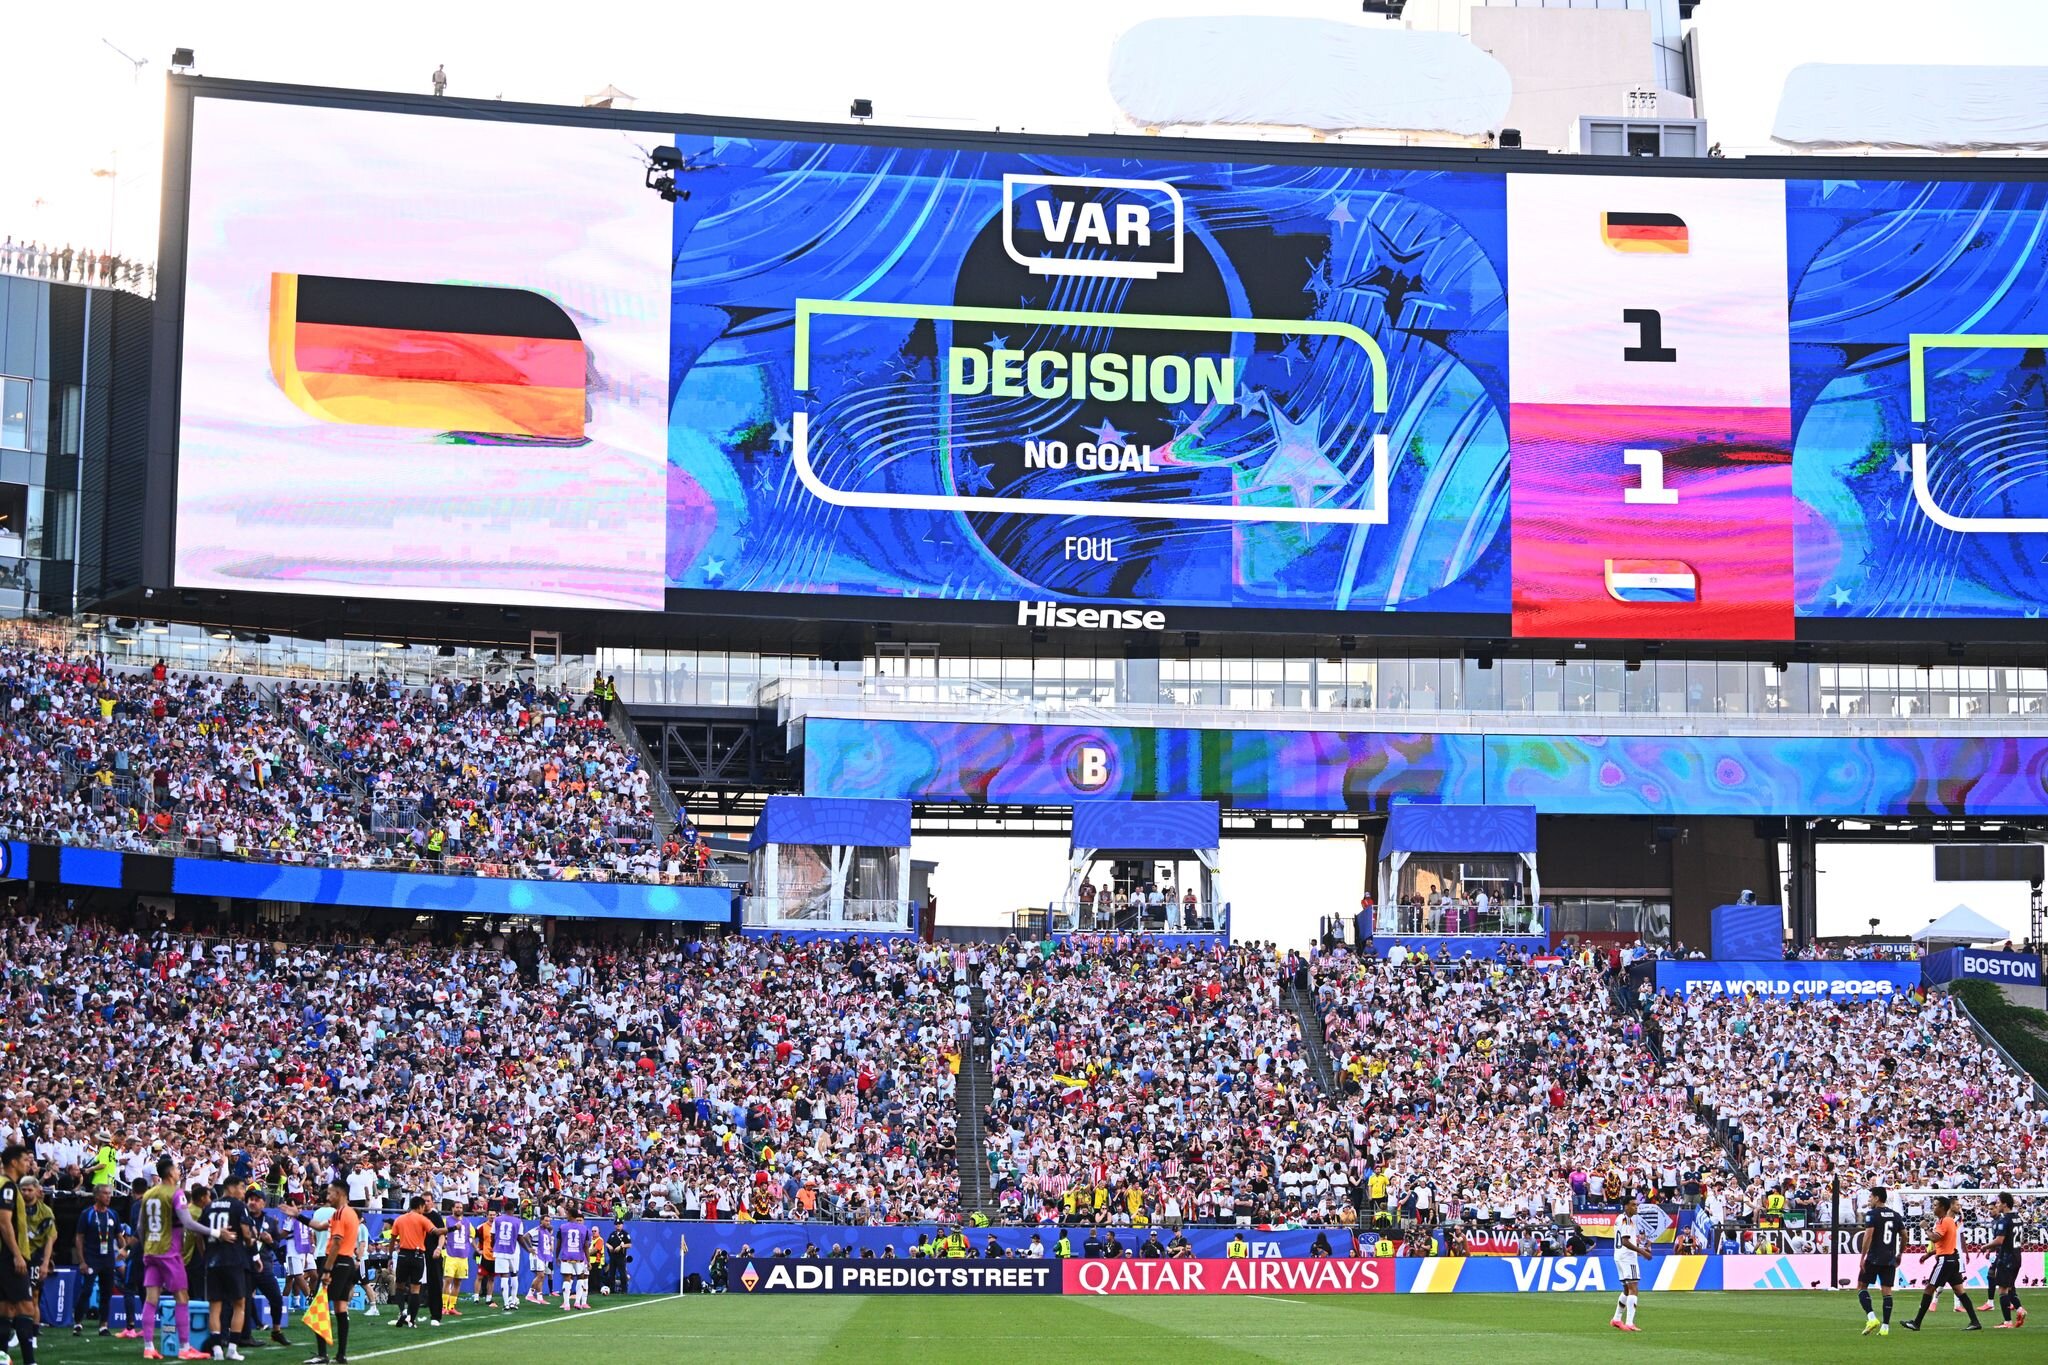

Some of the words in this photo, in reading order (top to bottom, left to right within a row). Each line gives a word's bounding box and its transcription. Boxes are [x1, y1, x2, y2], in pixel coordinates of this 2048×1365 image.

[1036, 200, 1151, 246] VAR
[1623, 308, 1677, 363] 1
[948, 346, 1235, 405] DECISION
[1024, 440, 1068, 469] NO
[1075, 442, 1160, 473] GOAL
[1623, 449, 1679, 505] 1
[1065, 536, 1118, 562] FOUL
[1017, 600, 1166, 630] Hisense
[1083, 747, 1108, 785] B
[1879, 944, 1893, 953] UD
[1963, 956, 2036, 978] BOSTON
[1685, 980, 1723, 995] FIFA
[1725, 980, 1790, 995] WORLD
[1792, 980, 1829, 995] CUP
[1830, 980, 1892, 995] 2026
[208, 1211, 230, 1231] 10
[1883, 1220, 1894, 1245] 6
[1463, 1229, 1489, 1247] AD
[764, 1265, 833, 1289] ADI
[842, 1268, 1050, 1287] PREDICTSTREET
[1079, 1261, 1205, 1295] QATAR
[1221, 1261, 1379, 1289] AIRWAYS
[1501, 1256, 1606, 1292] VISA
